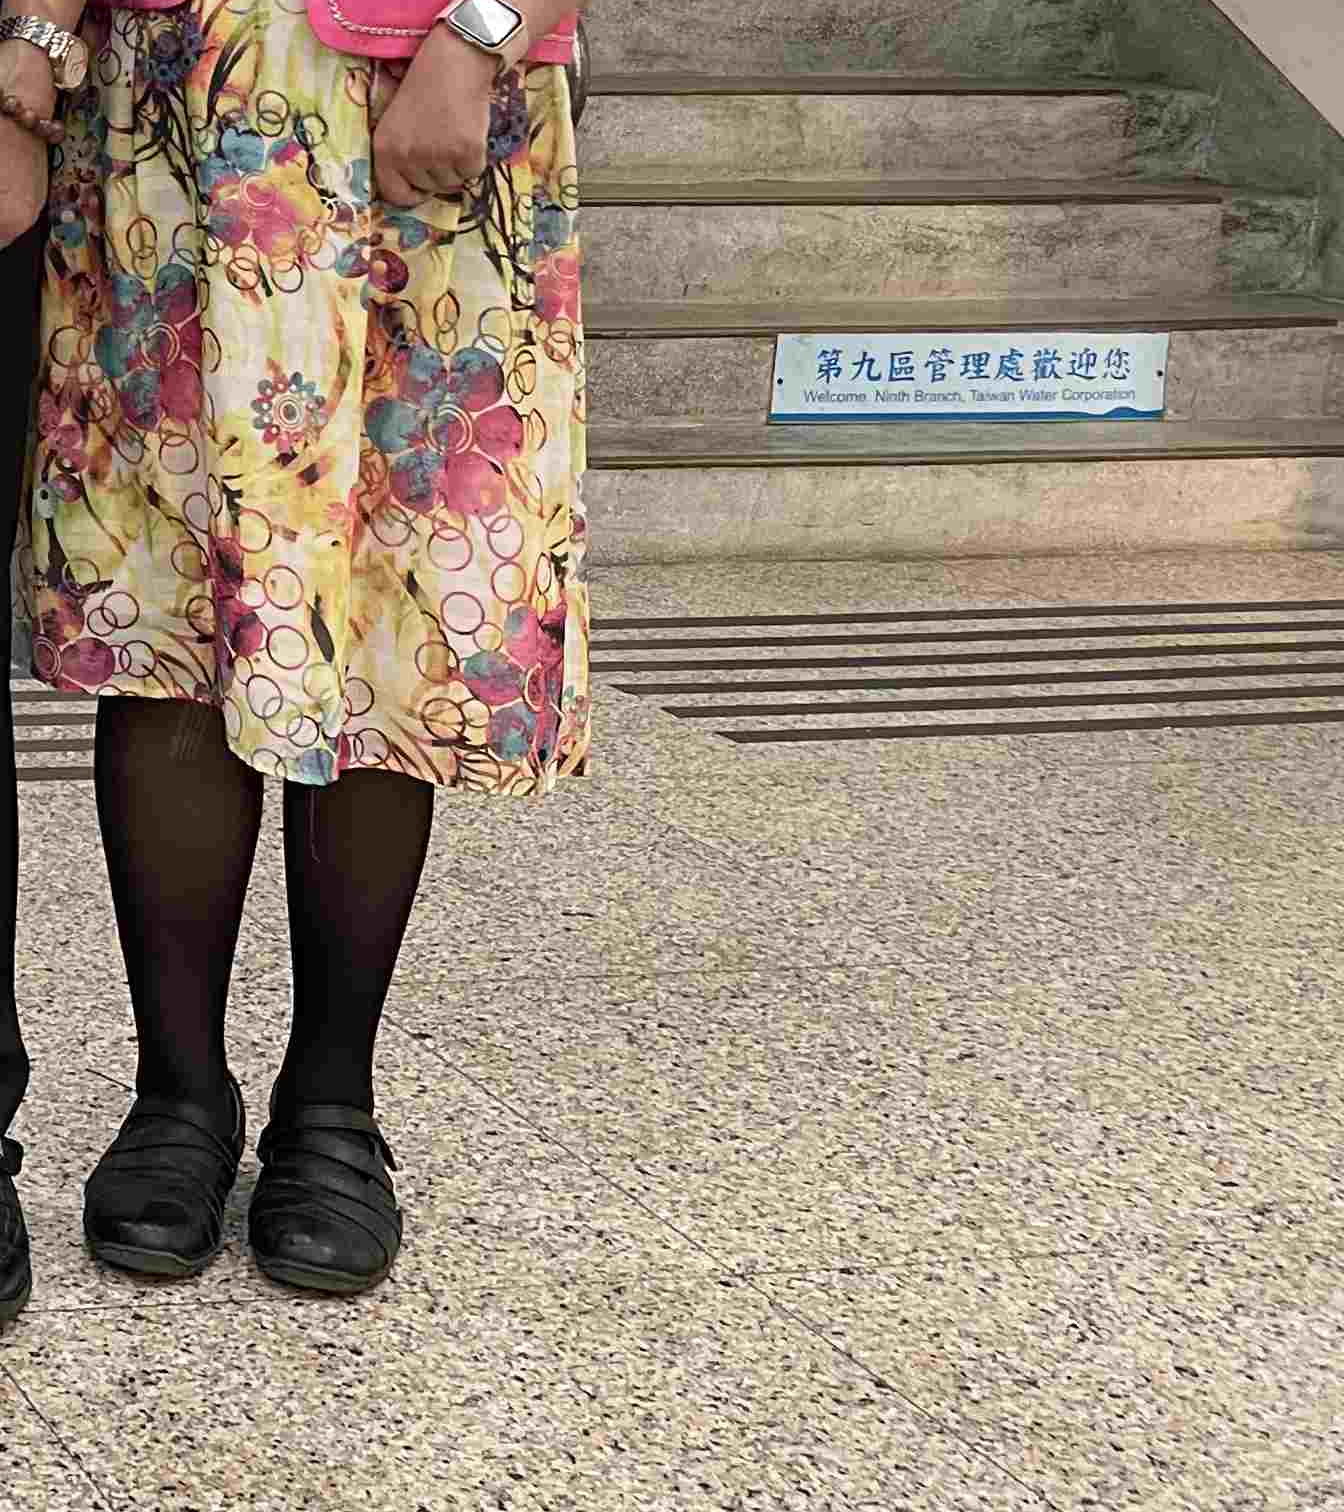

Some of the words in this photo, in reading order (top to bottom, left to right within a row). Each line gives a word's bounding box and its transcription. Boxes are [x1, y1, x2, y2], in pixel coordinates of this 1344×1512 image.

[815, 347, 1131, 384] 第九區管理處歡迎您
[874, 389, 910, 402] Ninth
[969, 389, 1015, 402] Taiwan
[1019, 388, 1057, 401] Water
[1061, 387, 1136, 402] Corporation
